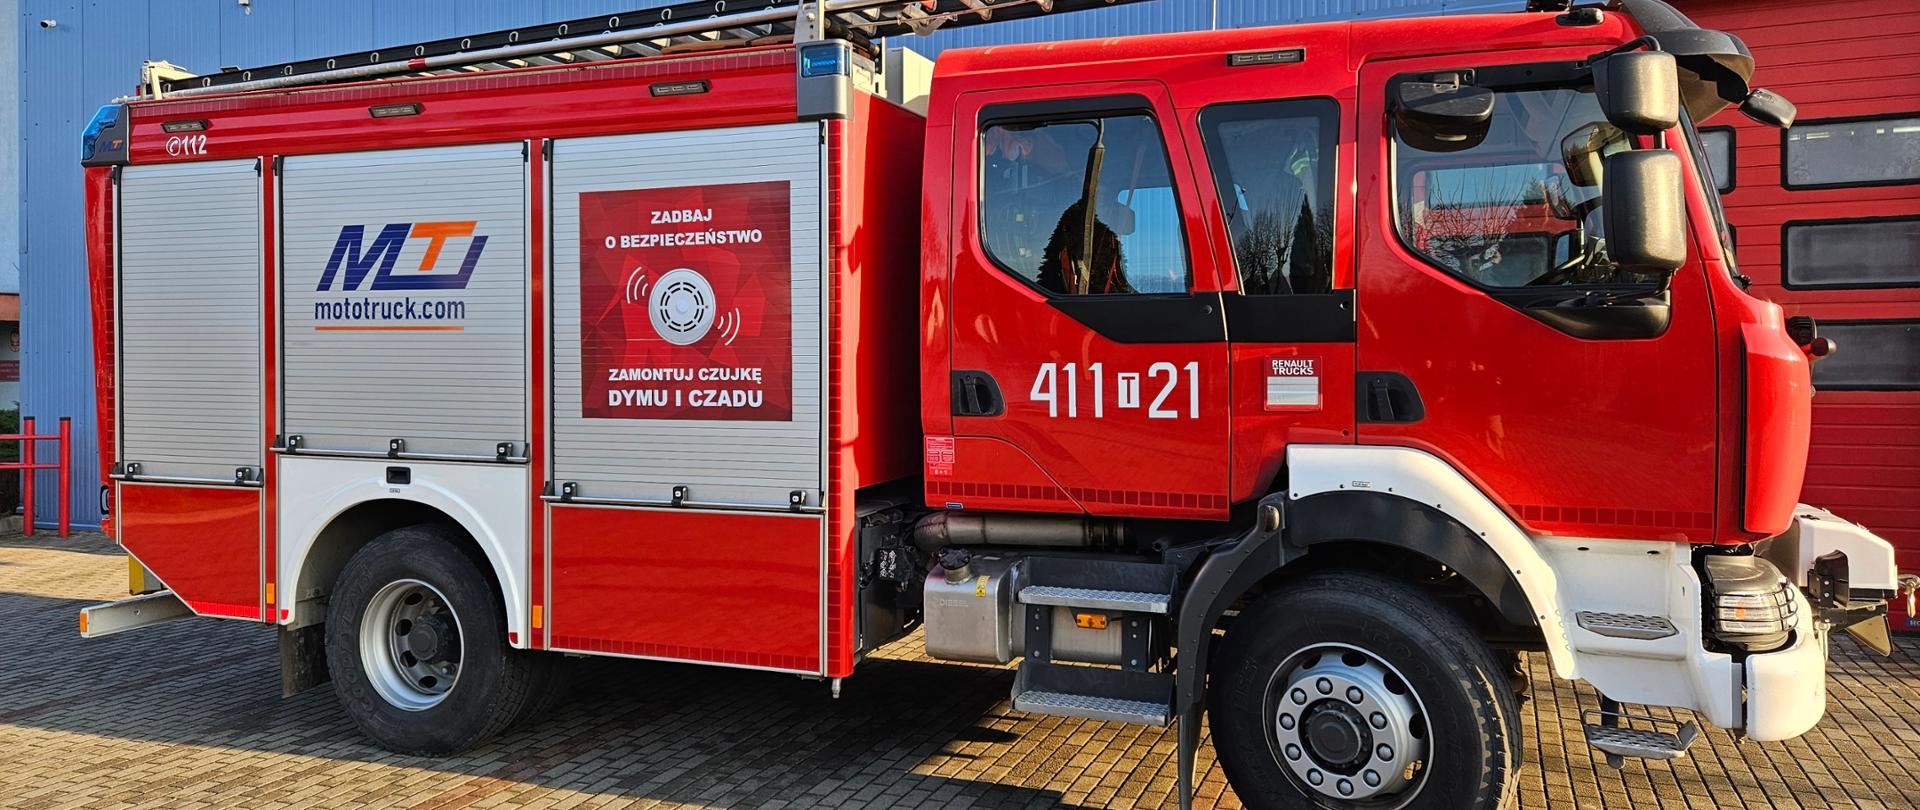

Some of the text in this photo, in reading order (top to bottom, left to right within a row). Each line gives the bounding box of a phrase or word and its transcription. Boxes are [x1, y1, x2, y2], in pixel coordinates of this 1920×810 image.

[181, 134, 208, 156] 112
[650, 208, 713, 225] ZADBAJ
[604, 228, 763, 249] O BEZPIECZEŃSTWO
[314, 297, 466, 320] mototruck.com
[1271, 359, 1315, 368] RENAULT
[1272, 367, 1315, 376] TRUCKS
[608, 367, 763, 384] ZAMONTUJ CZUJKĘ
[608, 389, 763, 408] DYMU I CZADU
[1030, 362, 1104, 418] 411
[1148, 361, 1200, 419] 21
